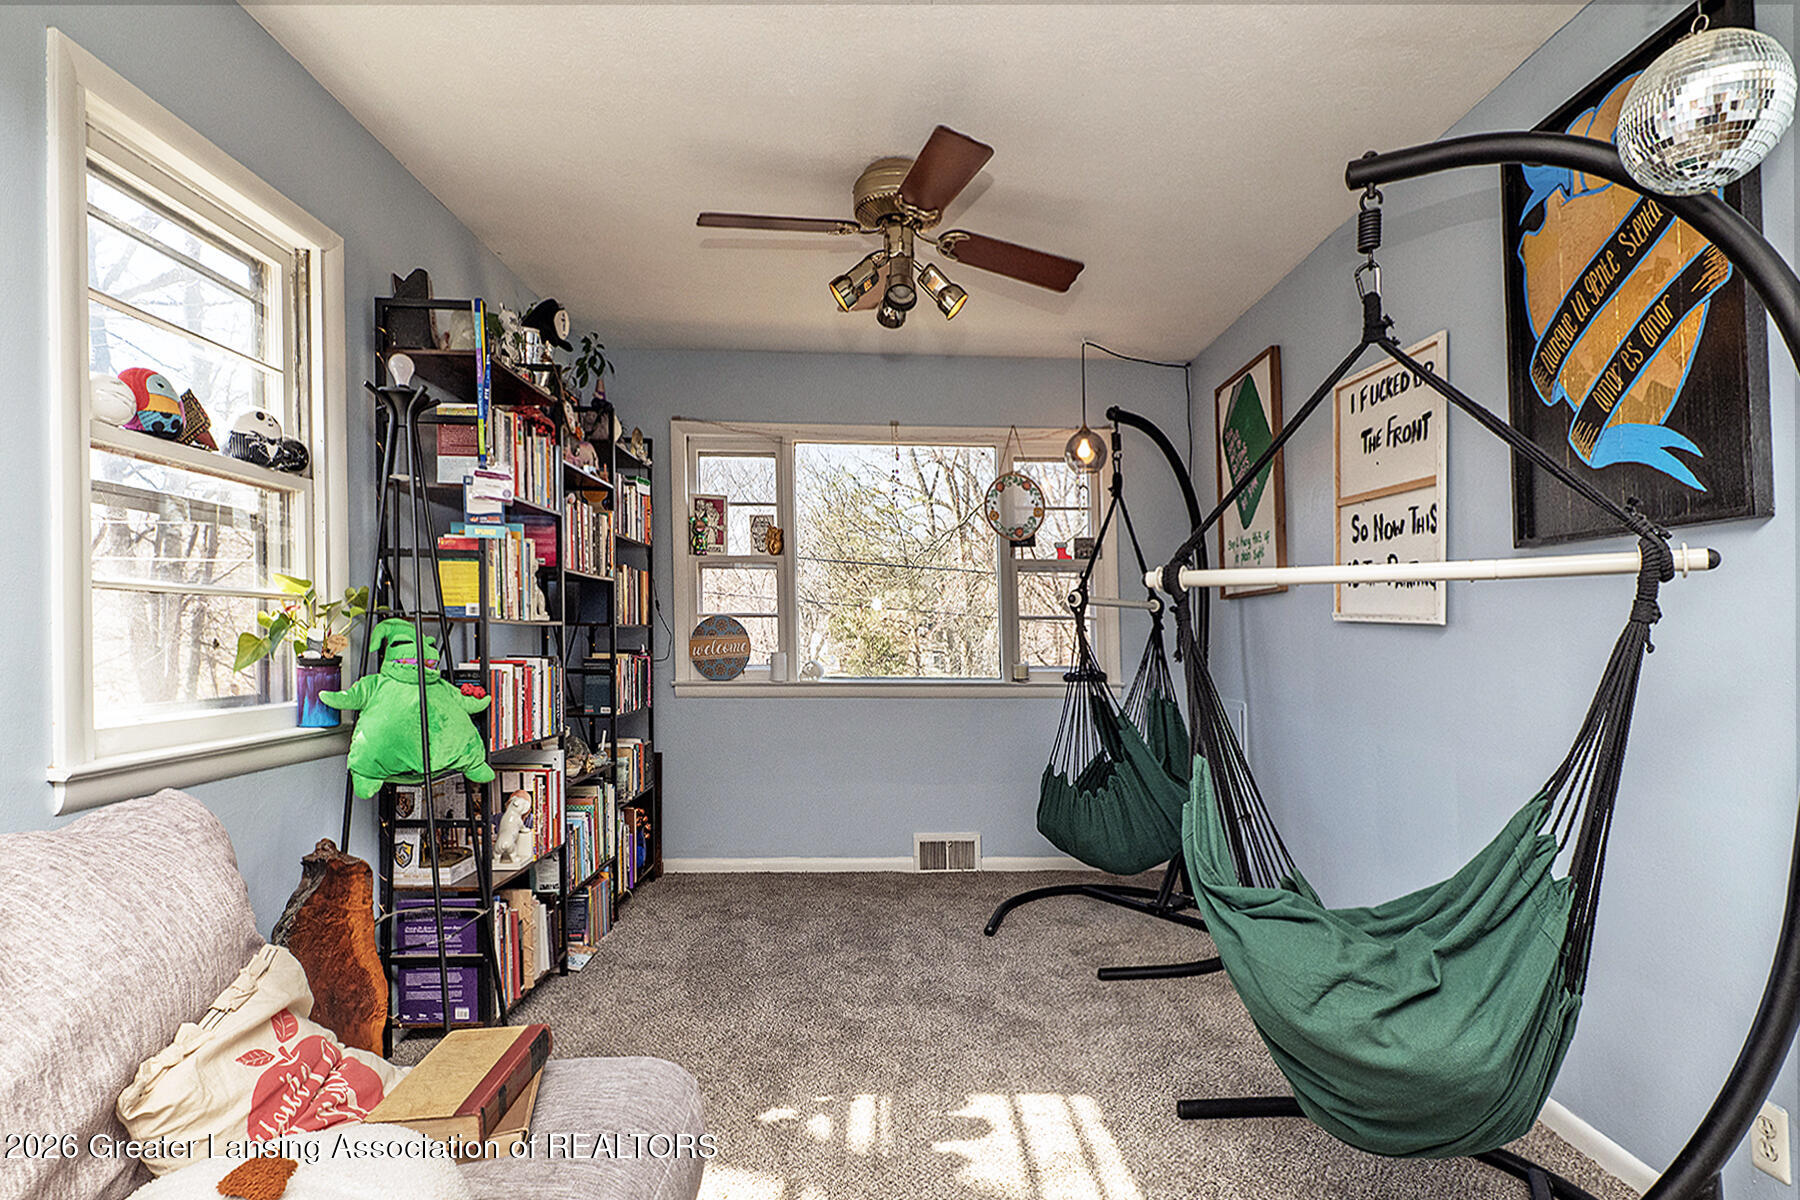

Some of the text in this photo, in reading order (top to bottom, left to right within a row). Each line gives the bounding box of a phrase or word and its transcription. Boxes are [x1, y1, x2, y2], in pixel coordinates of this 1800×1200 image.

[1570, 291, 1591, 322] la
[1584, 249, 1621, 305] gente
[1592, 294, 1674, 413] amor es amor
[1351, 393, 1355, 415] I
[1360, 371, 1411, 413] FUCKED
[1361, 411, 1433, 454] THE FRONT
[1408, 503, 1438, 535] THIS
[692, 639, 747, 656] welcome
